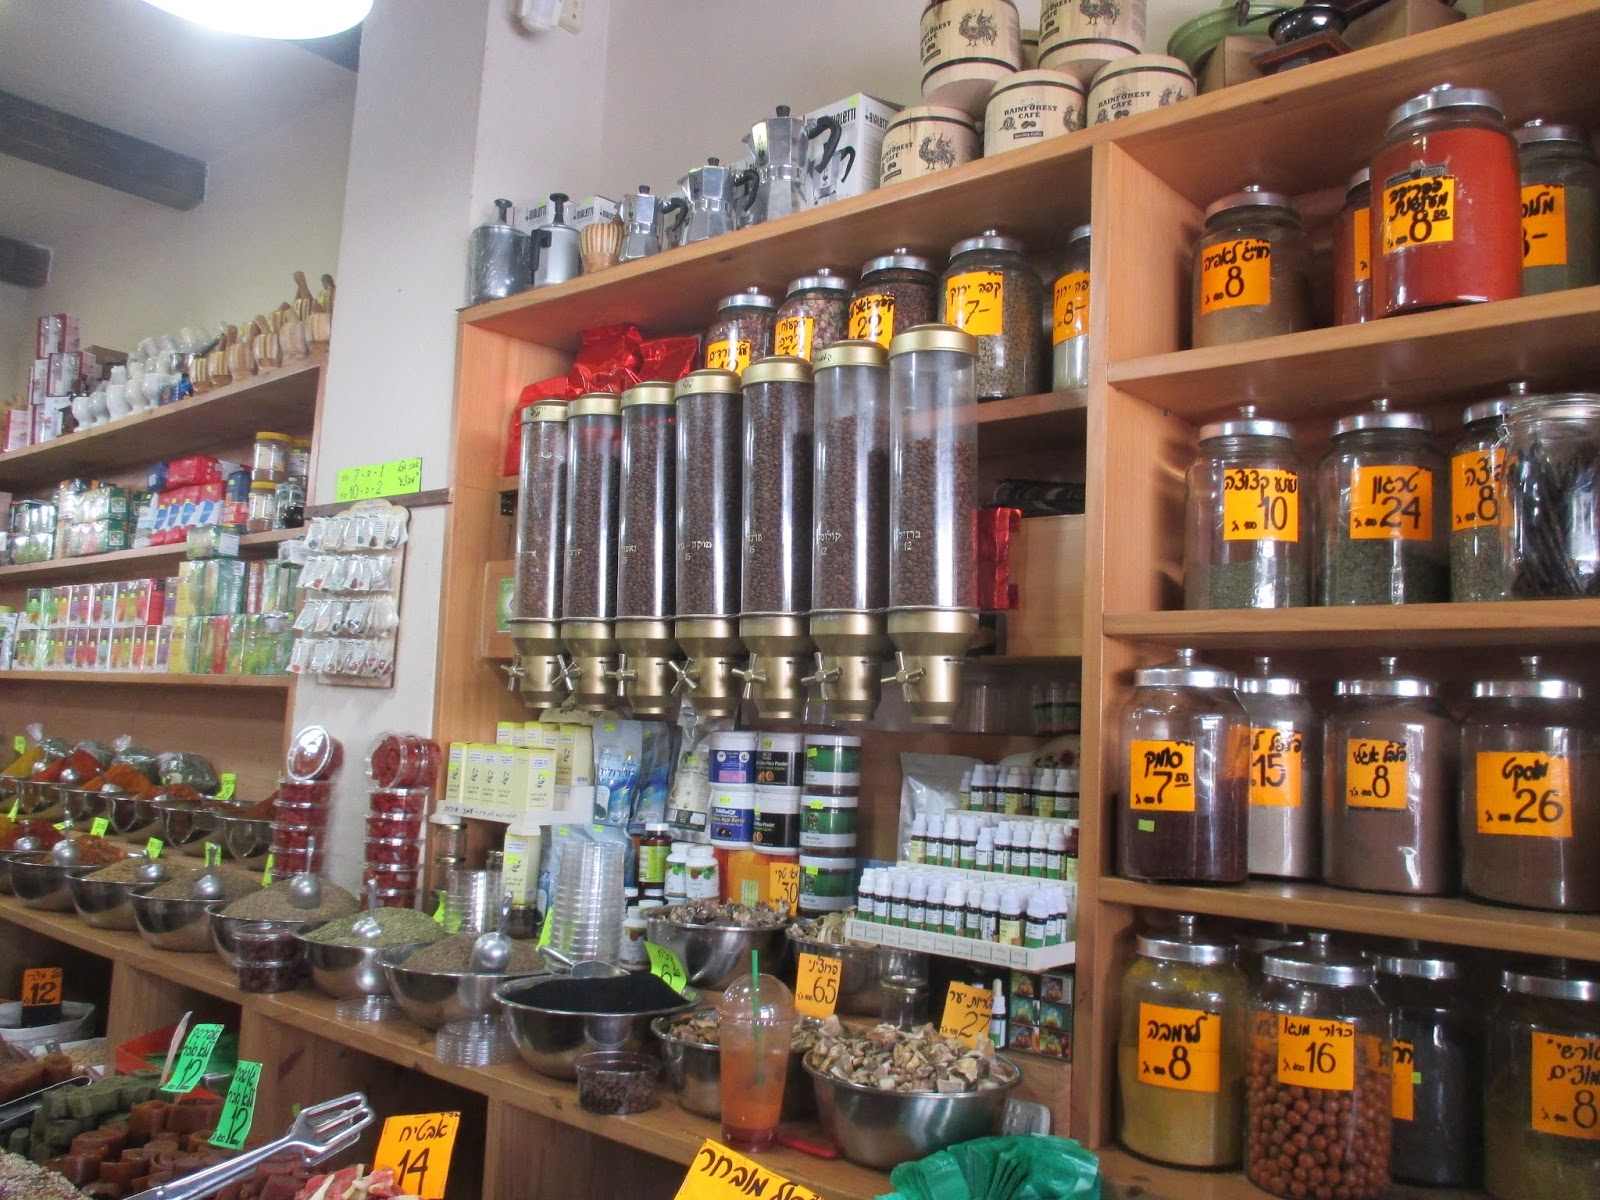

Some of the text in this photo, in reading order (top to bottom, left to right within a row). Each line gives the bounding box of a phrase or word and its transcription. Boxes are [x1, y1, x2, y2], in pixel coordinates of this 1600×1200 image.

[1004, 104, 1058, 116] RAINFOREST
[1018, 110, 1041, 119] CAFÉ
[1098, 91, 1151, 108] RAINFOREST
[1111, 100, 1133, 110] CAFÉ
[1410, 209, 1432, 243] 8
[950, 282, 1001, 307] קפה ירוק
[1225, 266, 1244, 298] 8
[1224, 469, 1270, 502] קצוצה
[1372, 470, 1419, 505] טרגון
[1257, 496, 1288, 531] 10
[1380, 496, 1421, 529] 24
[1478, 485, 1498, 521] 8
[1244, 521, 1257, 530] 100
[1253, 753, 1287, 787] 15
[1372, 764, 1390, 798] 8
[1153, 771, 1172, 804] 7
[1514, 788, 1564, 823] 26
[782, 882, 798, 904] 30
[30, 981, 57, 1004] 12
[813, 977, 837, 1005] 65
[949, 990, 967, 1005] יער
[958, 1011, 991, 1038] 27
[1284, 1016, 1353, 1037] כדורי מנגו
[1169, 1045, 1191, 1081] 8
[1305, 1041, 1336, 1073] 16
[177, 1058, 203, 1090] 12
[1573, 1089, 1598, 1129] 8
[225, 1106, 249, 1146] 12
[398, 1119, 448, 1143] אבטיח
[397, 1147, 431, 1196] 14
[699, 1148, 770, 1198] מובחר
